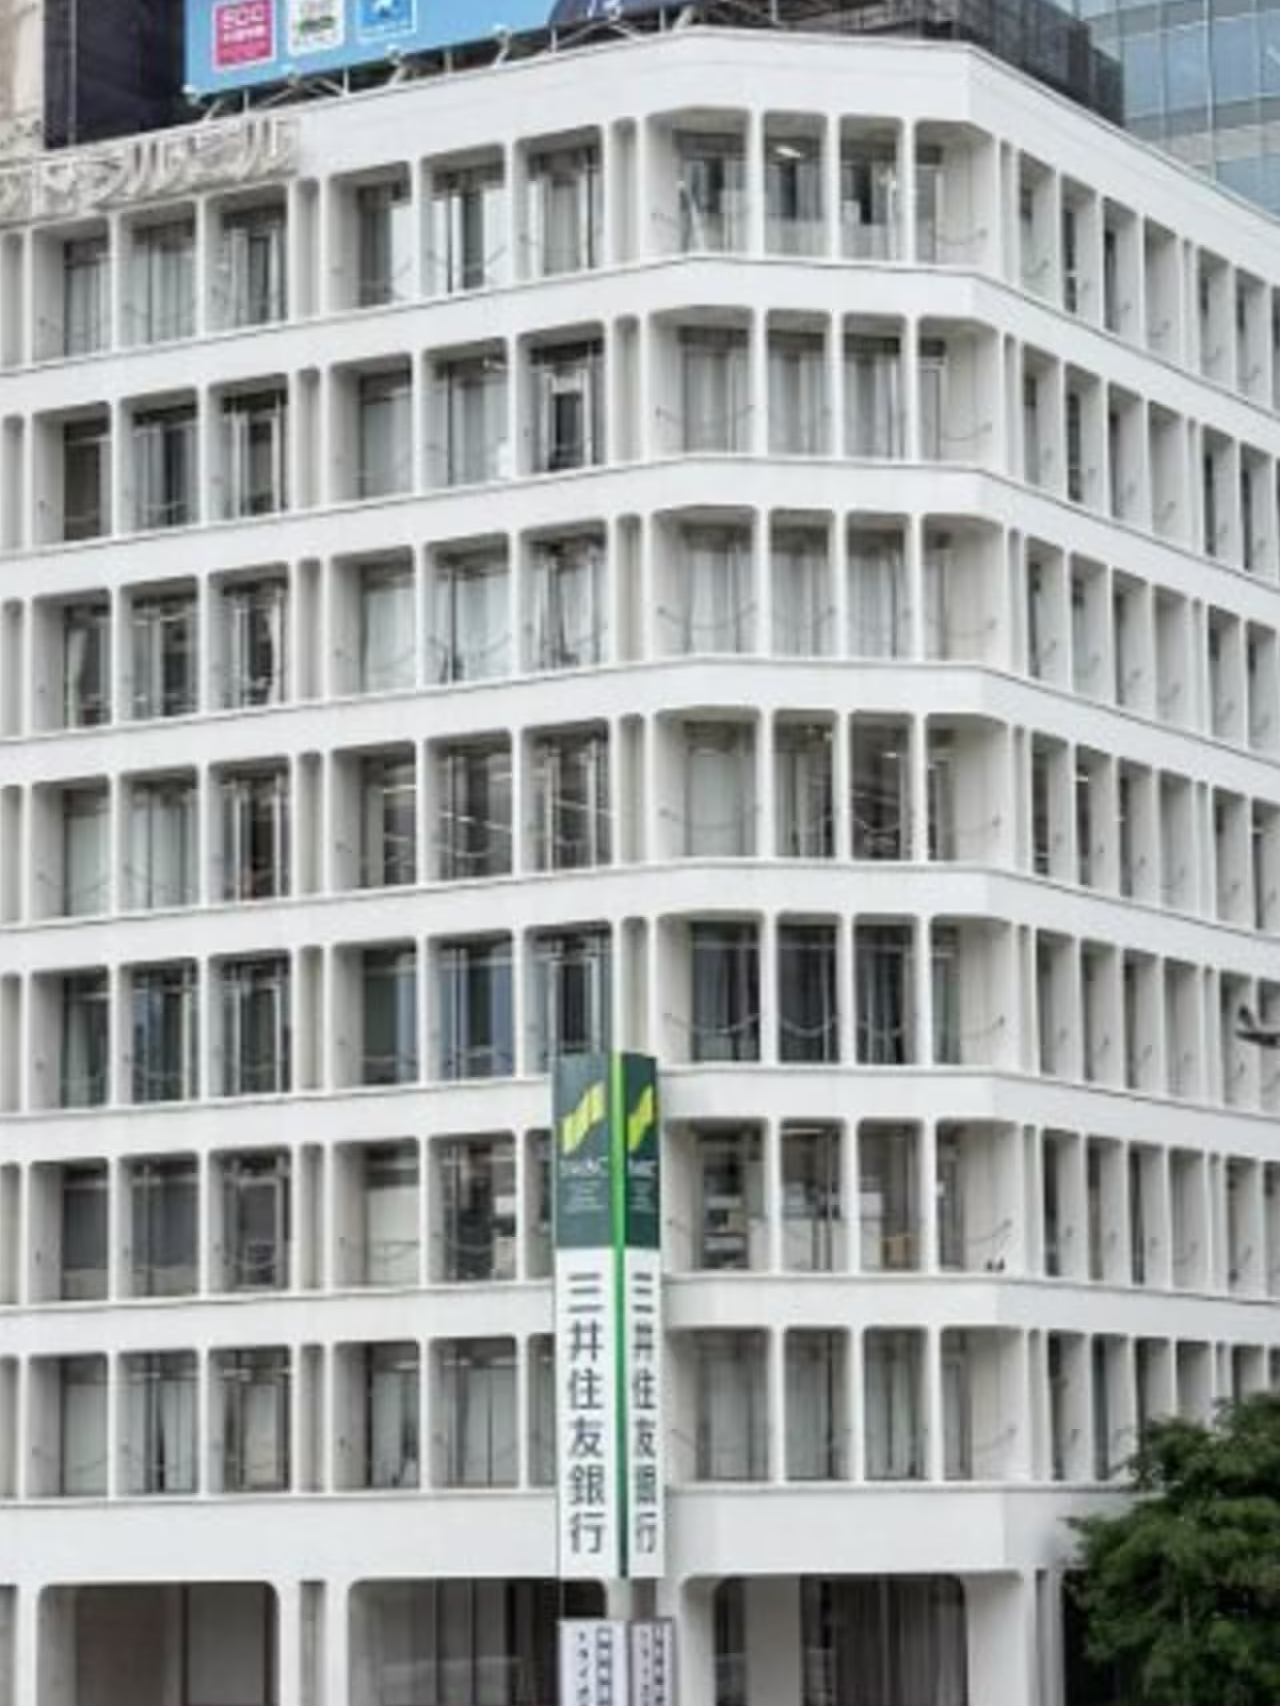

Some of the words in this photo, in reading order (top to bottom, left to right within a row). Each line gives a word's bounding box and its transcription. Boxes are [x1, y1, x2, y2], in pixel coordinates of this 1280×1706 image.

[567, 1271, 606, 1555] 三井住友銀行
[631, 1271, 657, 1555] 三井住友銀行
